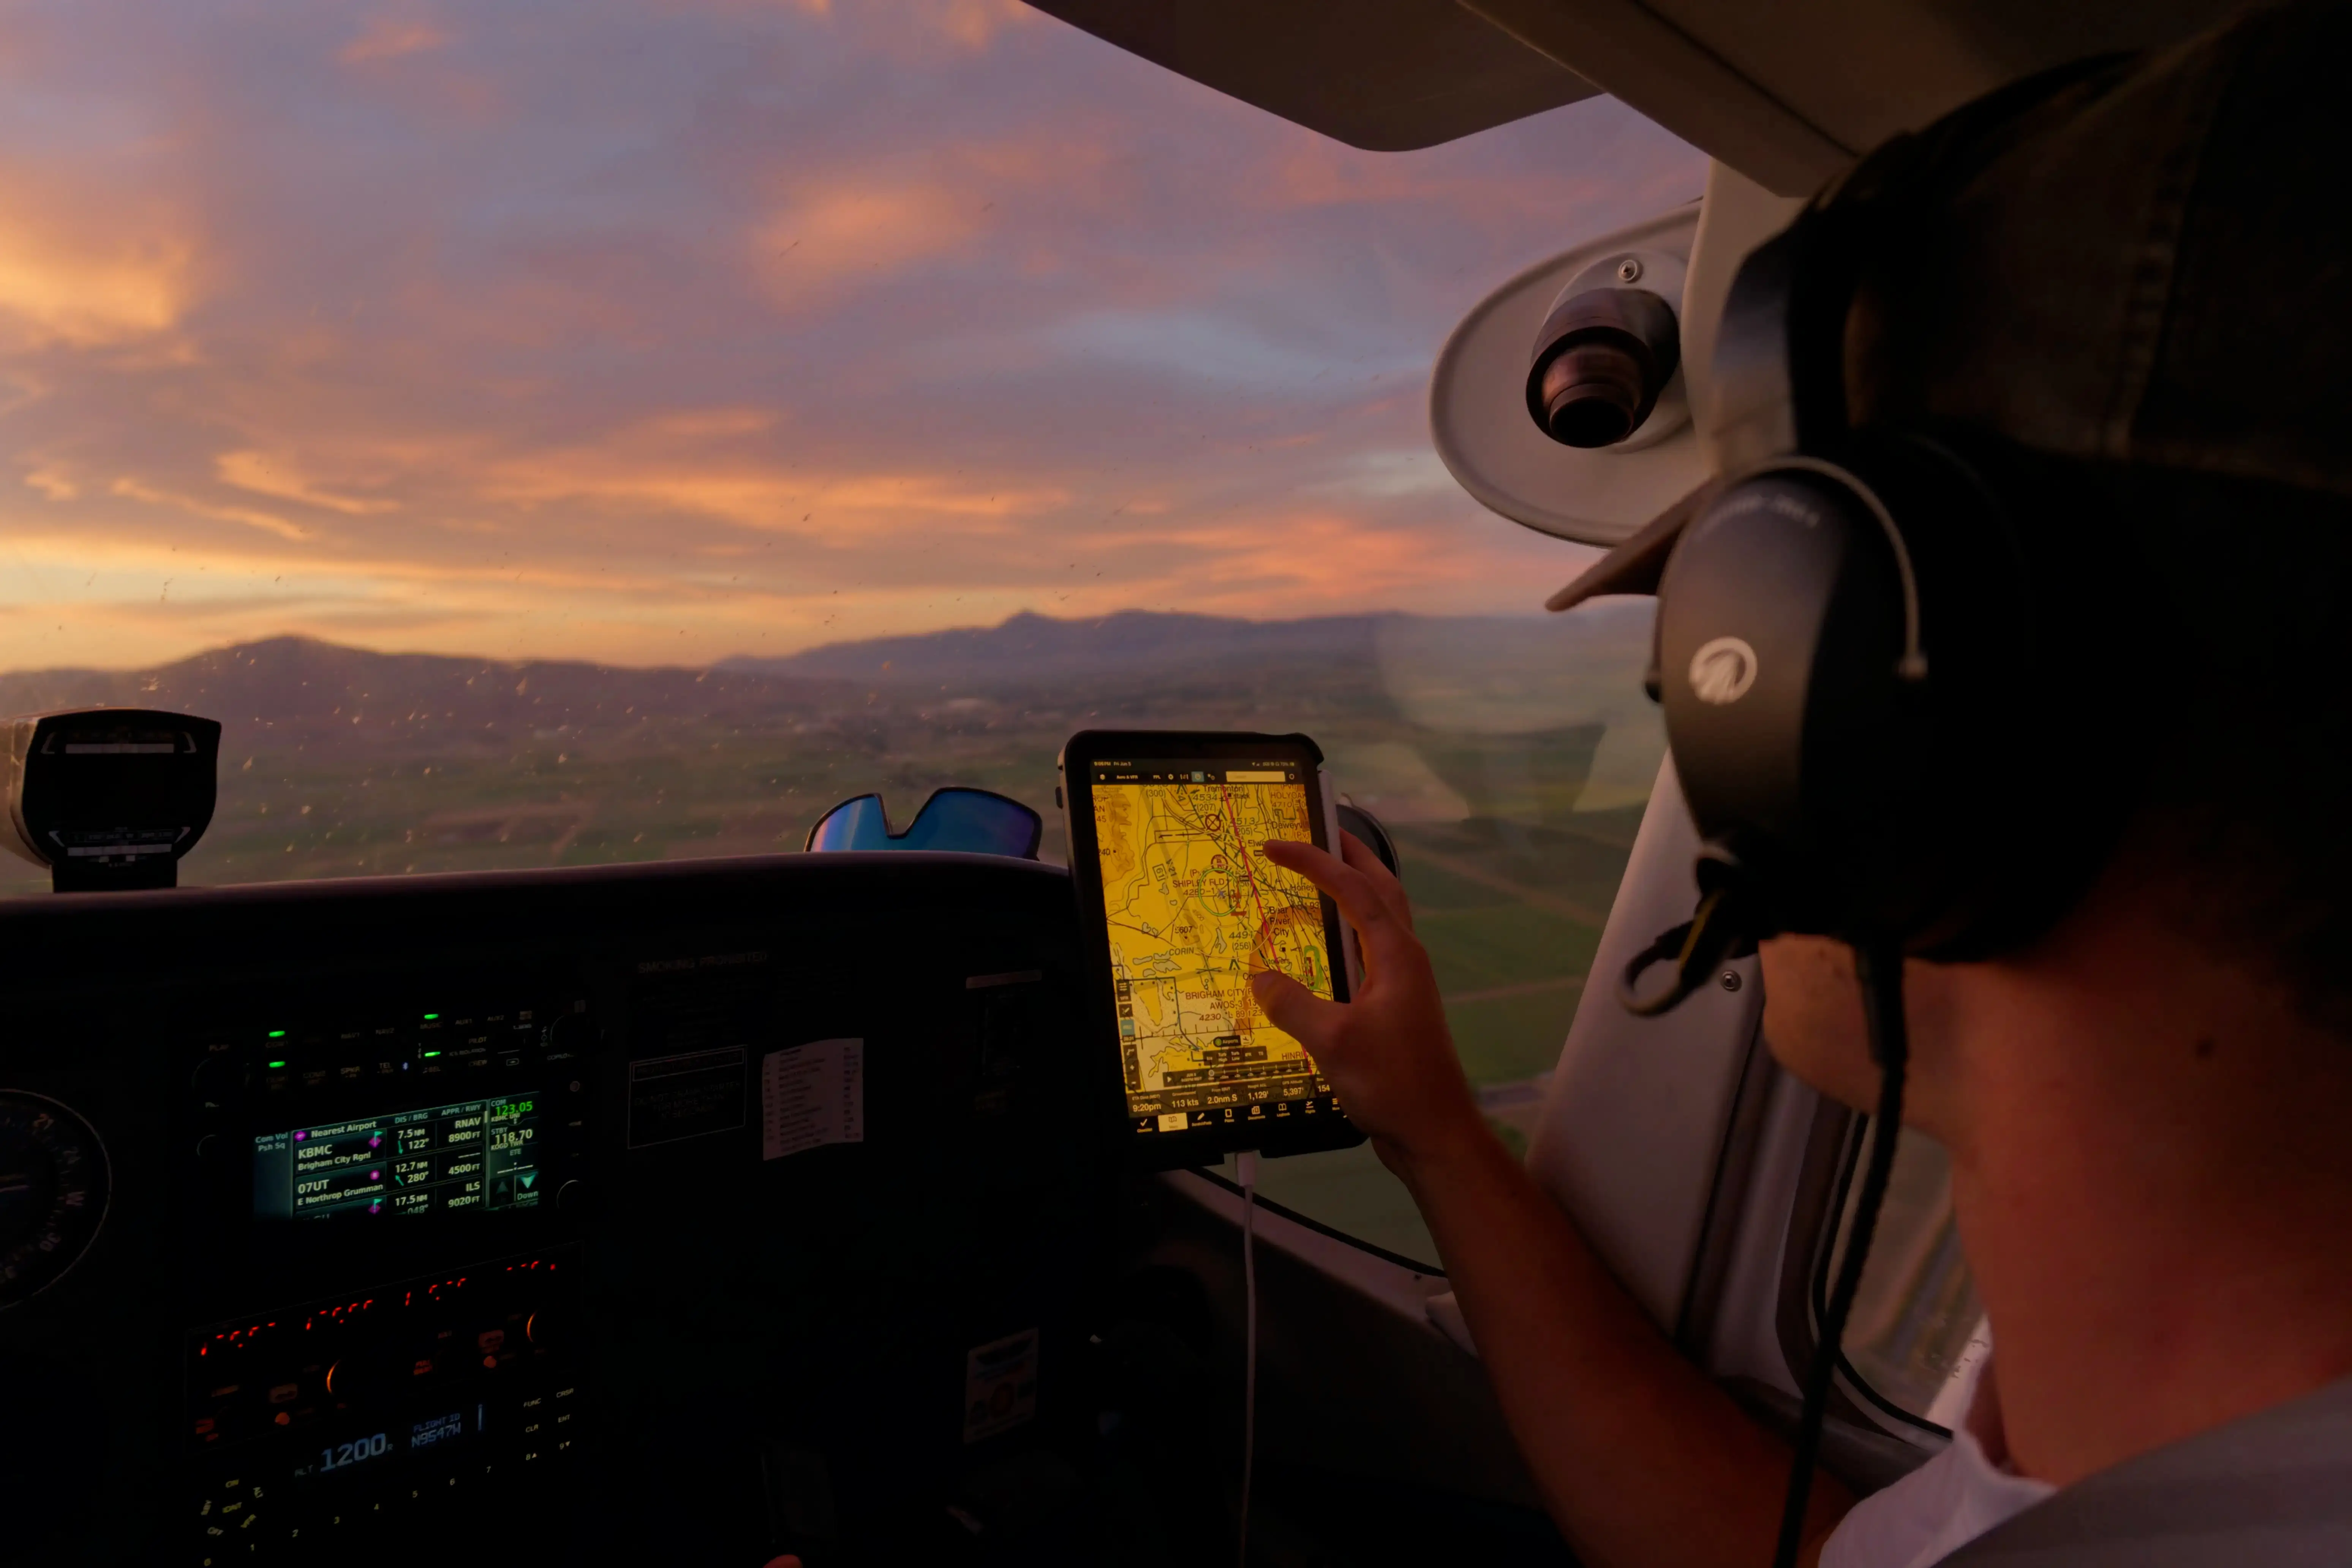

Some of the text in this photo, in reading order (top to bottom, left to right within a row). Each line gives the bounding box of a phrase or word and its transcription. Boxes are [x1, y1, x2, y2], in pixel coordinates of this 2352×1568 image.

[1146, 789, 1166, 798] (300)
[1197, 803, 1216, 812] (207)
[1274, 928, 1289, 937] City
[1170, 947, 1194, 956] CORIN
[1232, 942, 1252, 951] (256)
[638, 957, 695, 974] SMOKING
[1185, 990, 1225, 1000] BRIGHAM
[1227, 988, 1246, 997] CITY
[1210, 1000, 1243, 1010] AWOS-3
[1236, 1010, 1245, 1018] 89
[468, 1036, 487, 1045] PILOT
[1172, 1100, 1185, 1108] 113
[1207, 1096, 1230, 1104] 2.0nm
[441, 1107, 460, 1116] APPR
[466, 1104, 481, 1113] RWY
[496, 1101, 533, 1116] 123.05
[1132, 1103, 1162, 1112] 9:20pm
[413, 1113, 429, 1121] BRG
[455, 1117, 481, 1129] RNAV
[311, 1121, 377, 1138] Nearest Airport
[255, 1132, 288, 1144] Com Vol
[495, 1129, 534, 1144] 118.70
[258, 1142, 286, 1152] Psh Sq
[408, 1138, 430, 1150] 122°
[298, 1144, 333, 1160] KBMC
[298, 1151, 371, 1172] Brigham City Rgnl
[407, 1171, 429, 1184] 280°
[298, 1179, 330, 1194] 07UT
[466, 1181, 481, 1192] ILS
[305, 1192, 343, 1204] Northrop
[344, 1183, 384, 1197] Grumman
[517, 1190, 539, 1201] Down
[523, 1398, 542, 1408] FUNC
[413, 1412, 461, 1432] FLIGHT ID
[558, 1413, 571, 1423] ENT
[525, 1424, 539, 1433] CLR
[320, 1432, 386, 1473] 1200
[334, 1516, 341, 1524] 3
[292, 1528, 299, 1538] 2
[250, 1543, 255, 1552] 1
